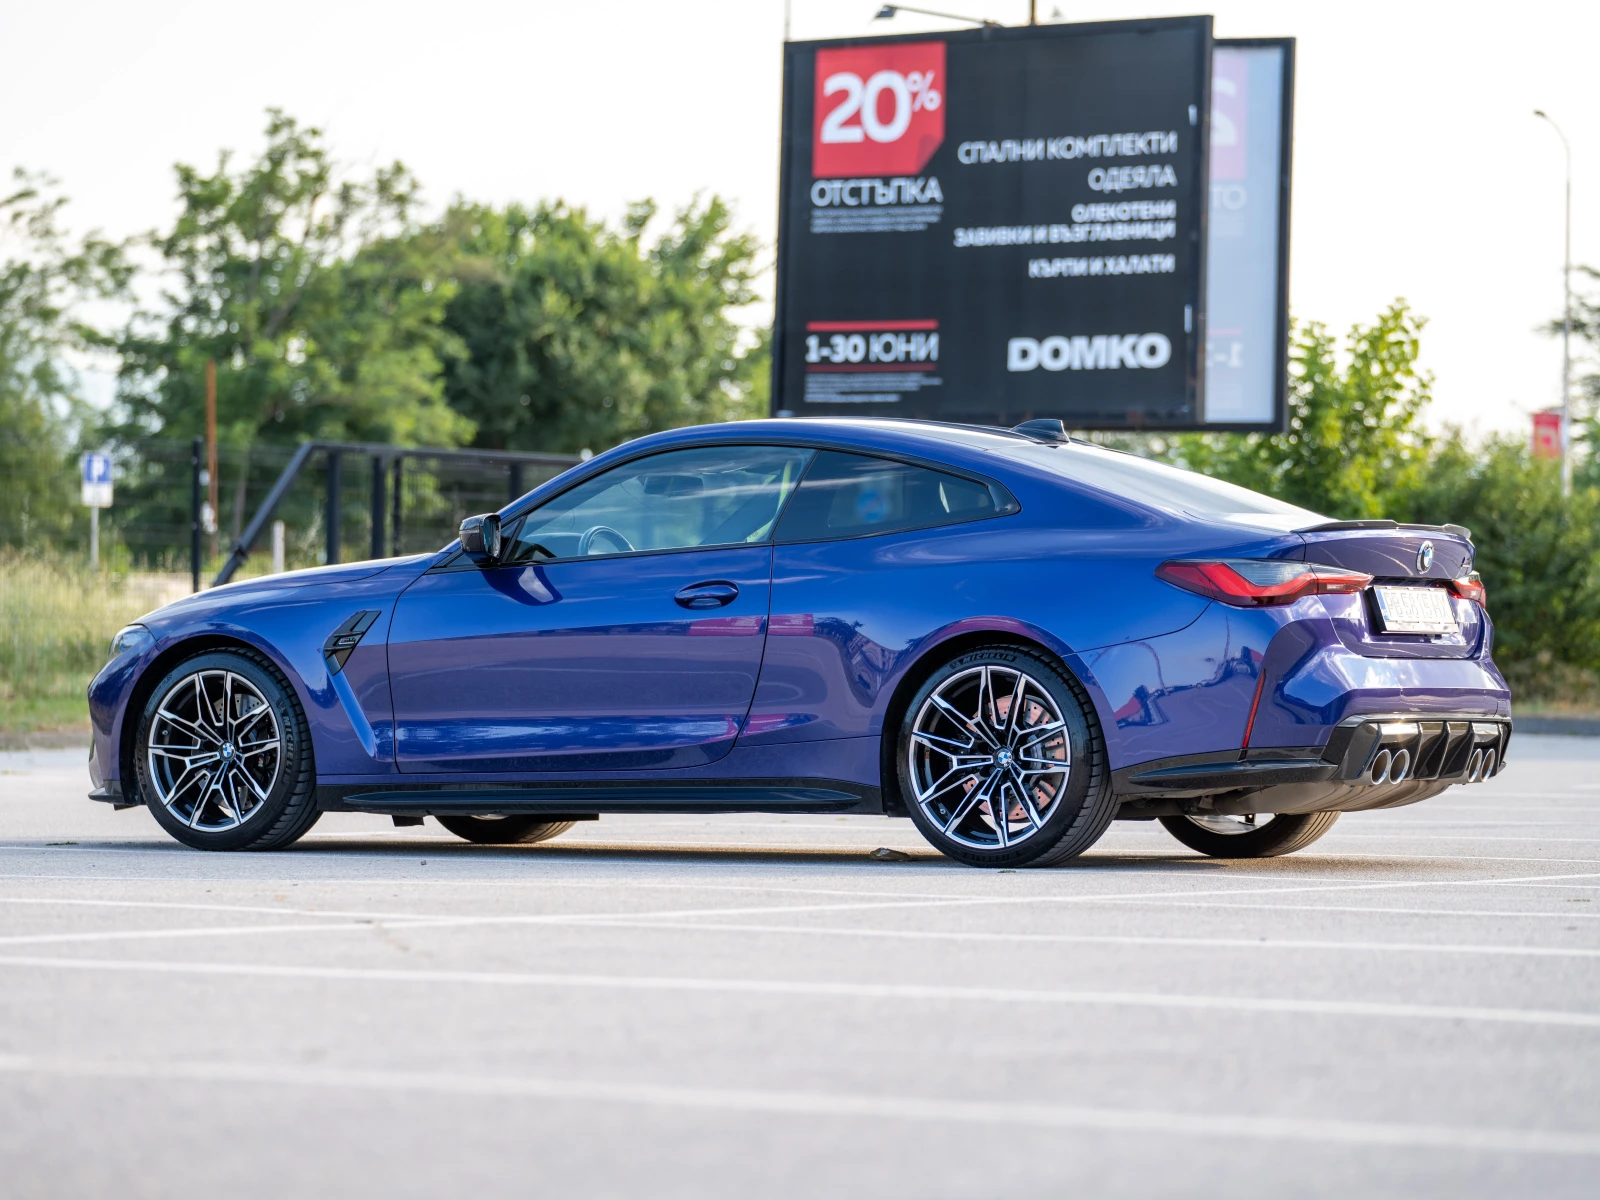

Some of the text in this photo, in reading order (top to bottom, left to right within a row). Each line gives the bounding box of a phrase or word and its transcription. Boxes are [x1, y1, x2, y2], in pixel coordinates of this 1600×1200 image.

[821, 69, 942, 143] 20%
[957, 130, 1178, 164] СПАЛНИ КОМПЛЕКТИ
[810, 176, 944, 206] ОТСТЪПКА
[1087, 164, 1178, 194] ОДЕЯЛА
[1033, 225, 1048, 244] И
[1089, 255, 1104, 276] И
[1104, 253, 1176, 276] ХАЛАТИ
[805, 332, 939, 363] 1-30 ЮНИ
[1006, 332, 1172, 372] DOMKO
[963, 652, 1016, 664] MICHELIN
[281, 715, 295, 784] MICHELIN
